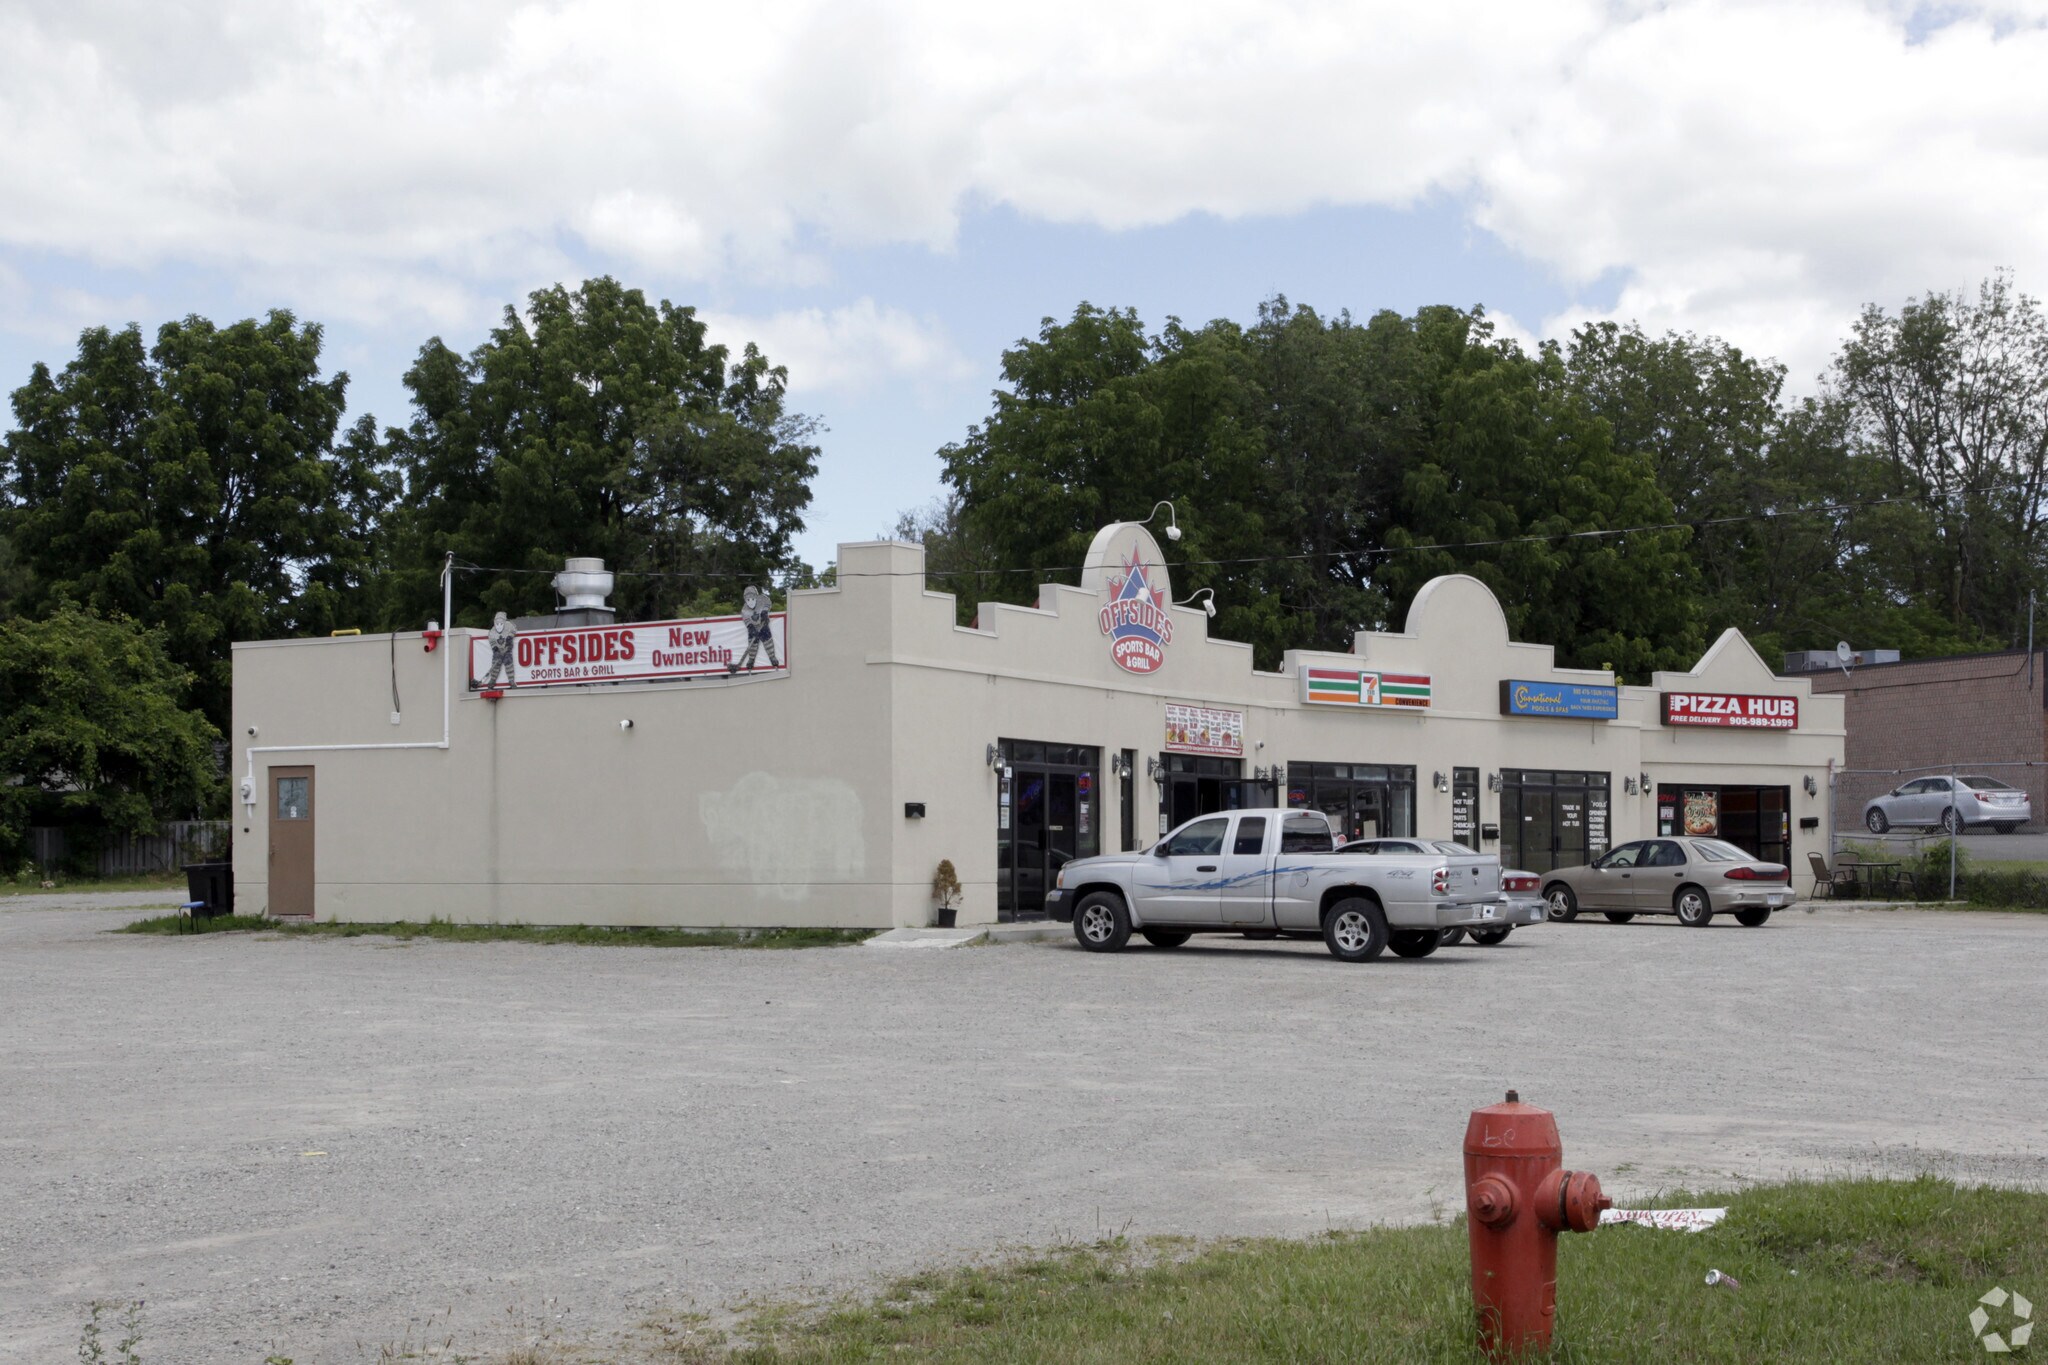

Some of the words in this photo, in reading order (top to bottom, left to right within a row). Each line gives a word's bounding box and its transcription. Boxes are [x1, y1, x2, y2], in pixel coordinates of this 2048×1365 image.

[1099, 599, 1174, 646] OFFSIDES
[668, 627, 710, 648] New
[517, 630, 635, 668] OFFSIDES
[652, 646, 733, 668] Ownership
[1116, 640, 1143, 657] SPORTS
[1144, 643, 1160, 662] BAR
[531, 668, 562, 680] SPORTS
[563, 667, 581, 678] BAR
[582, 666, 589, 676] &
[591, 664, 615, 676] GRILL
[1395, 697, 1430, 707] CONVENIENCE
[1674, 694, 1742, 714] PIZZA
[1748, 698, 1796, 716] HUB
[1688, 715, 1721, 723] DELIVERY
[1729, 716, 1794, 727] 905-989-1999
[1613, 1210, 1651, 1221] NOW
[1655, 1210, 1703, 1222] OPEN
